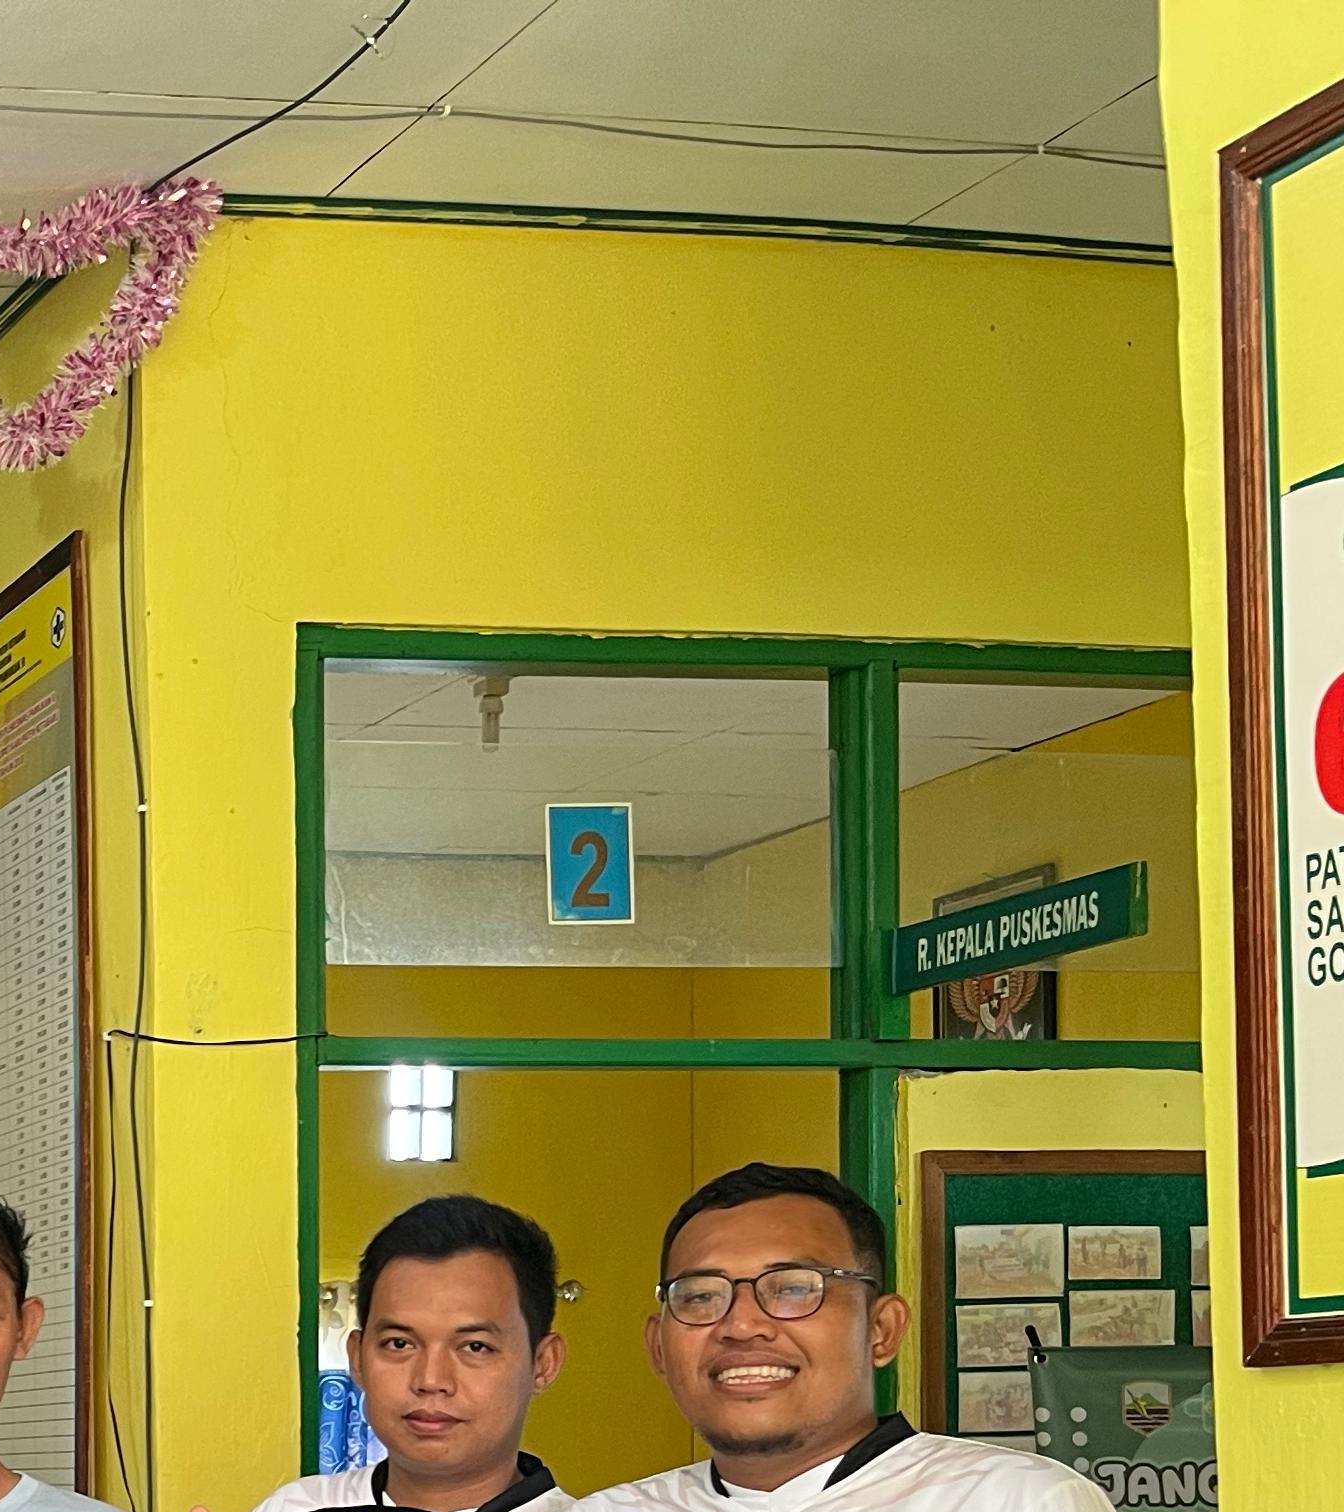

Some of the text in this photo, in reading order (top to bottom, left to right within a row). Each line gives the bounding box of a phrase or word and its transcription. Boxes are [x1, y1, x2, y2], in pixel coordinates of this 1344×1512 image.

[570, 830, 610, 908] 2
[1306, 846, 1344, 894] PA
[917, 890, 1099, 973] R. KEPALA PUSKESMAS
